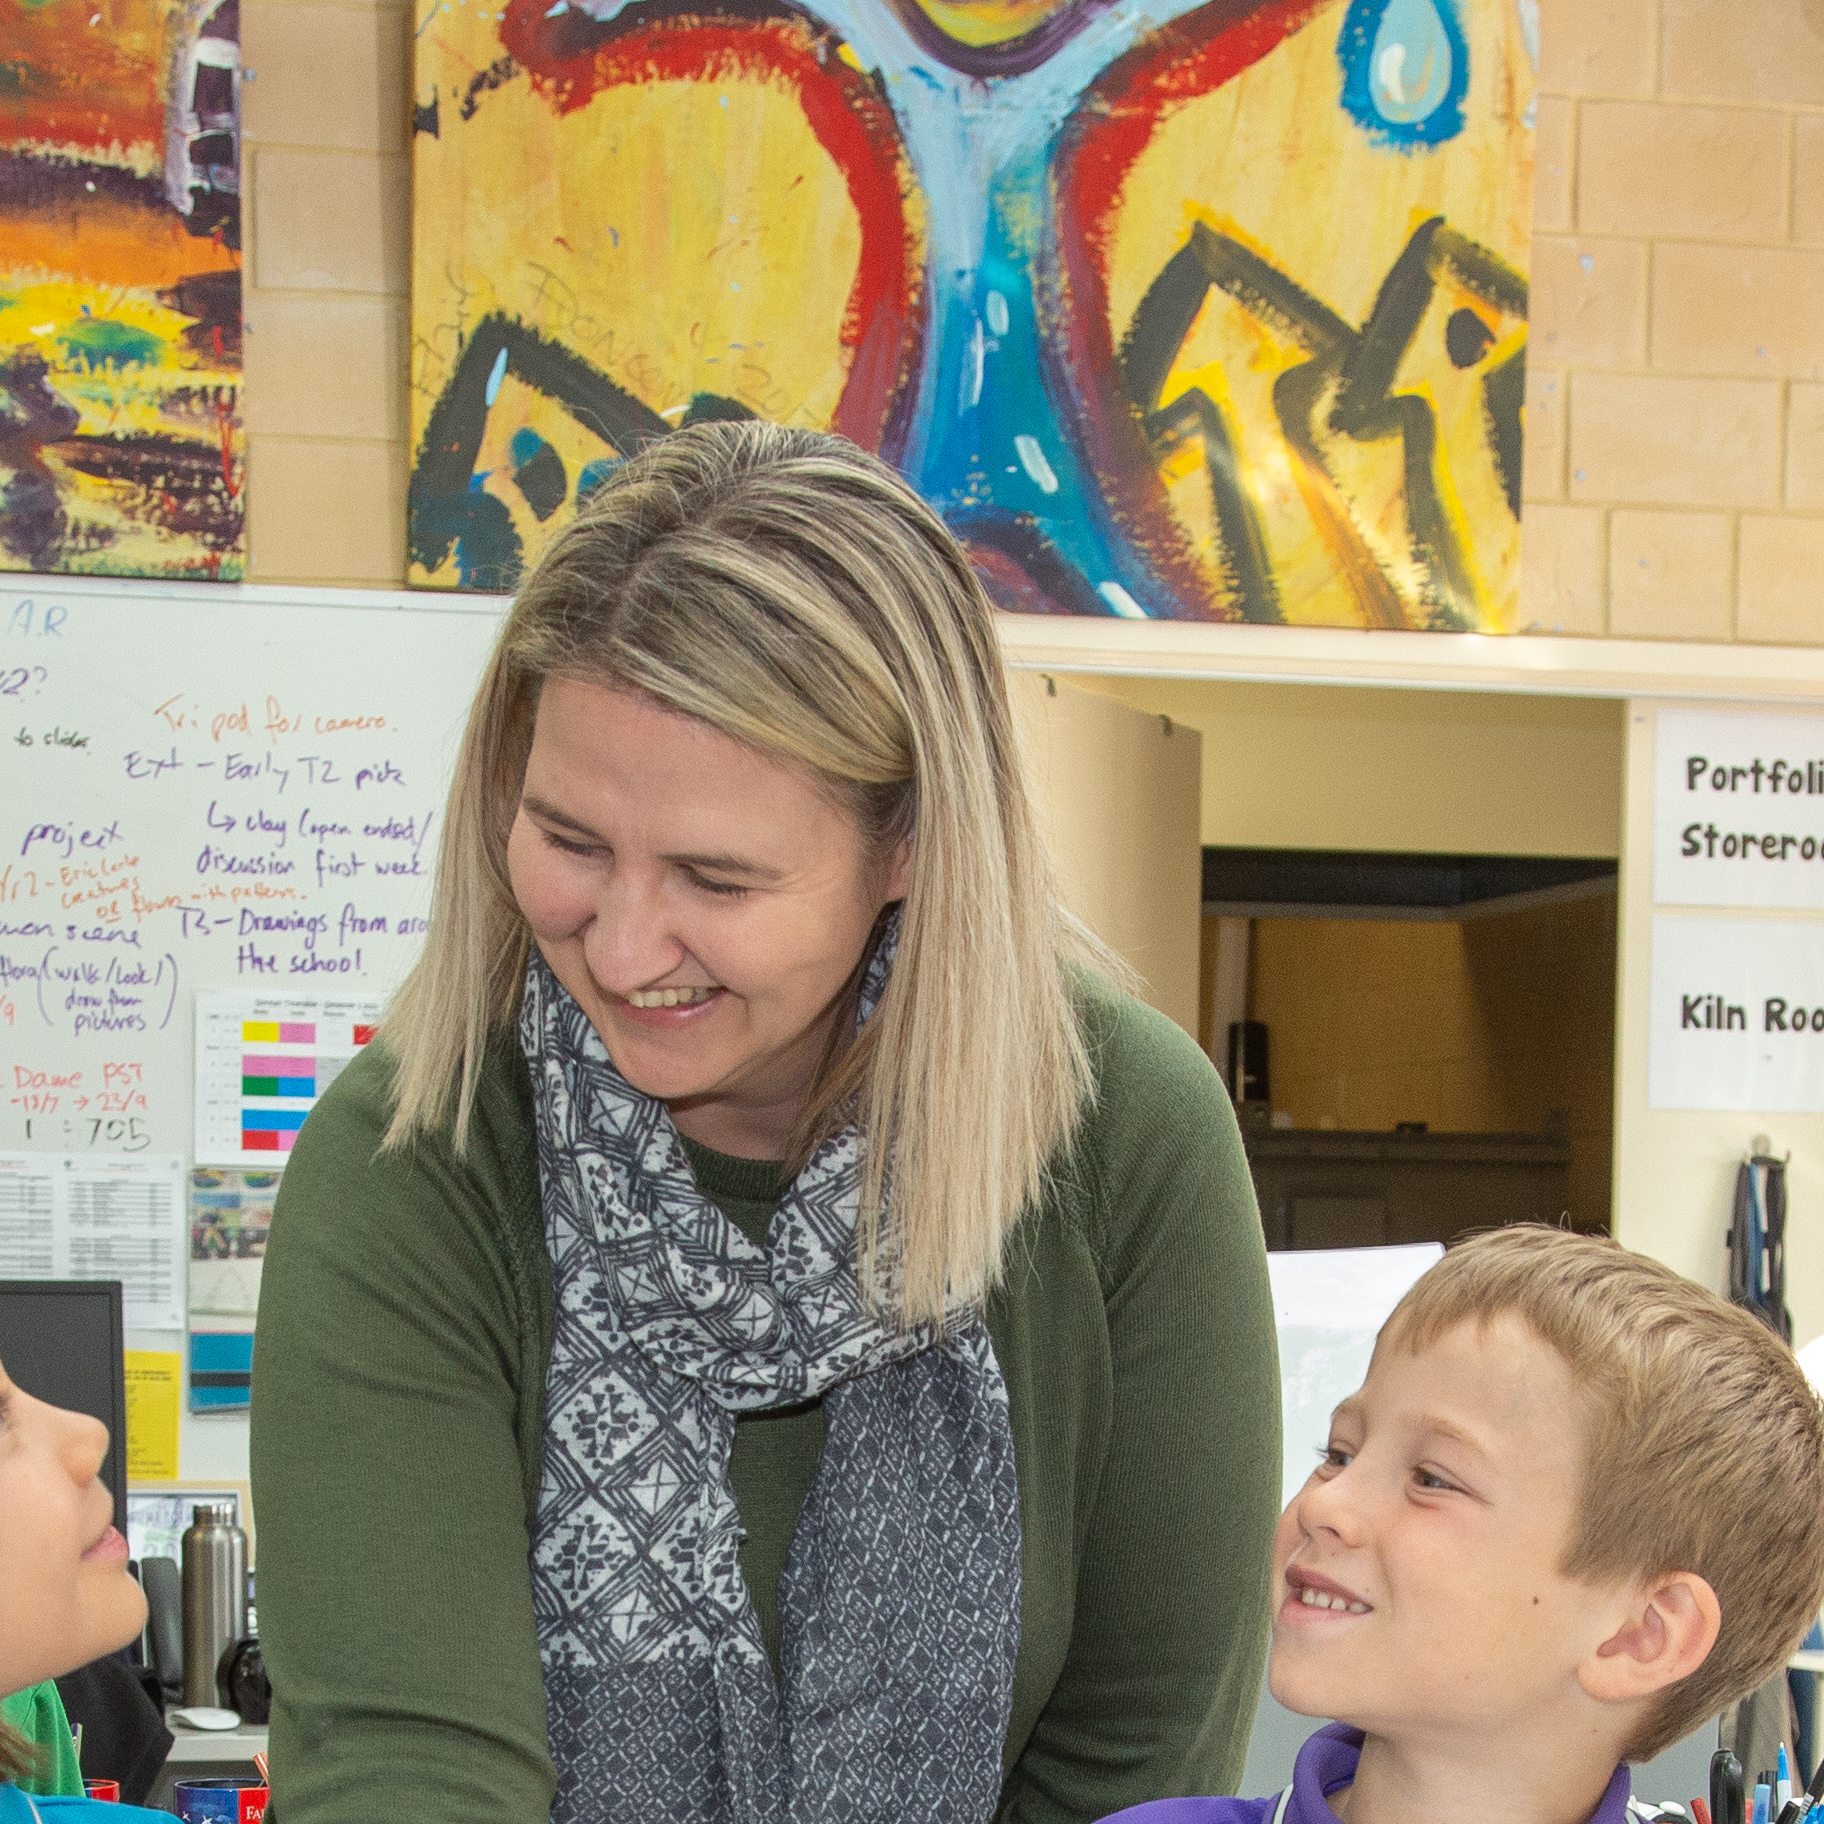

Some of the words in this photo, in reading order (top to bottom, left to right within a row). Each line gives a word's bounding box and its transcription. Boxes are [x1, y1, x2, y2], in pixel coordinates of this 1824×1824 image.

[19, 819, 125, 858] project
[314, 848, 367, 888] first
[339, 901, 389, 947] from
[237, 941, 279, 975] the
[1681, 992, 1748, 1032] Kiln
[13, 1064, 84, 1089] Dame
[85, 1115, 152, 1153] 705
